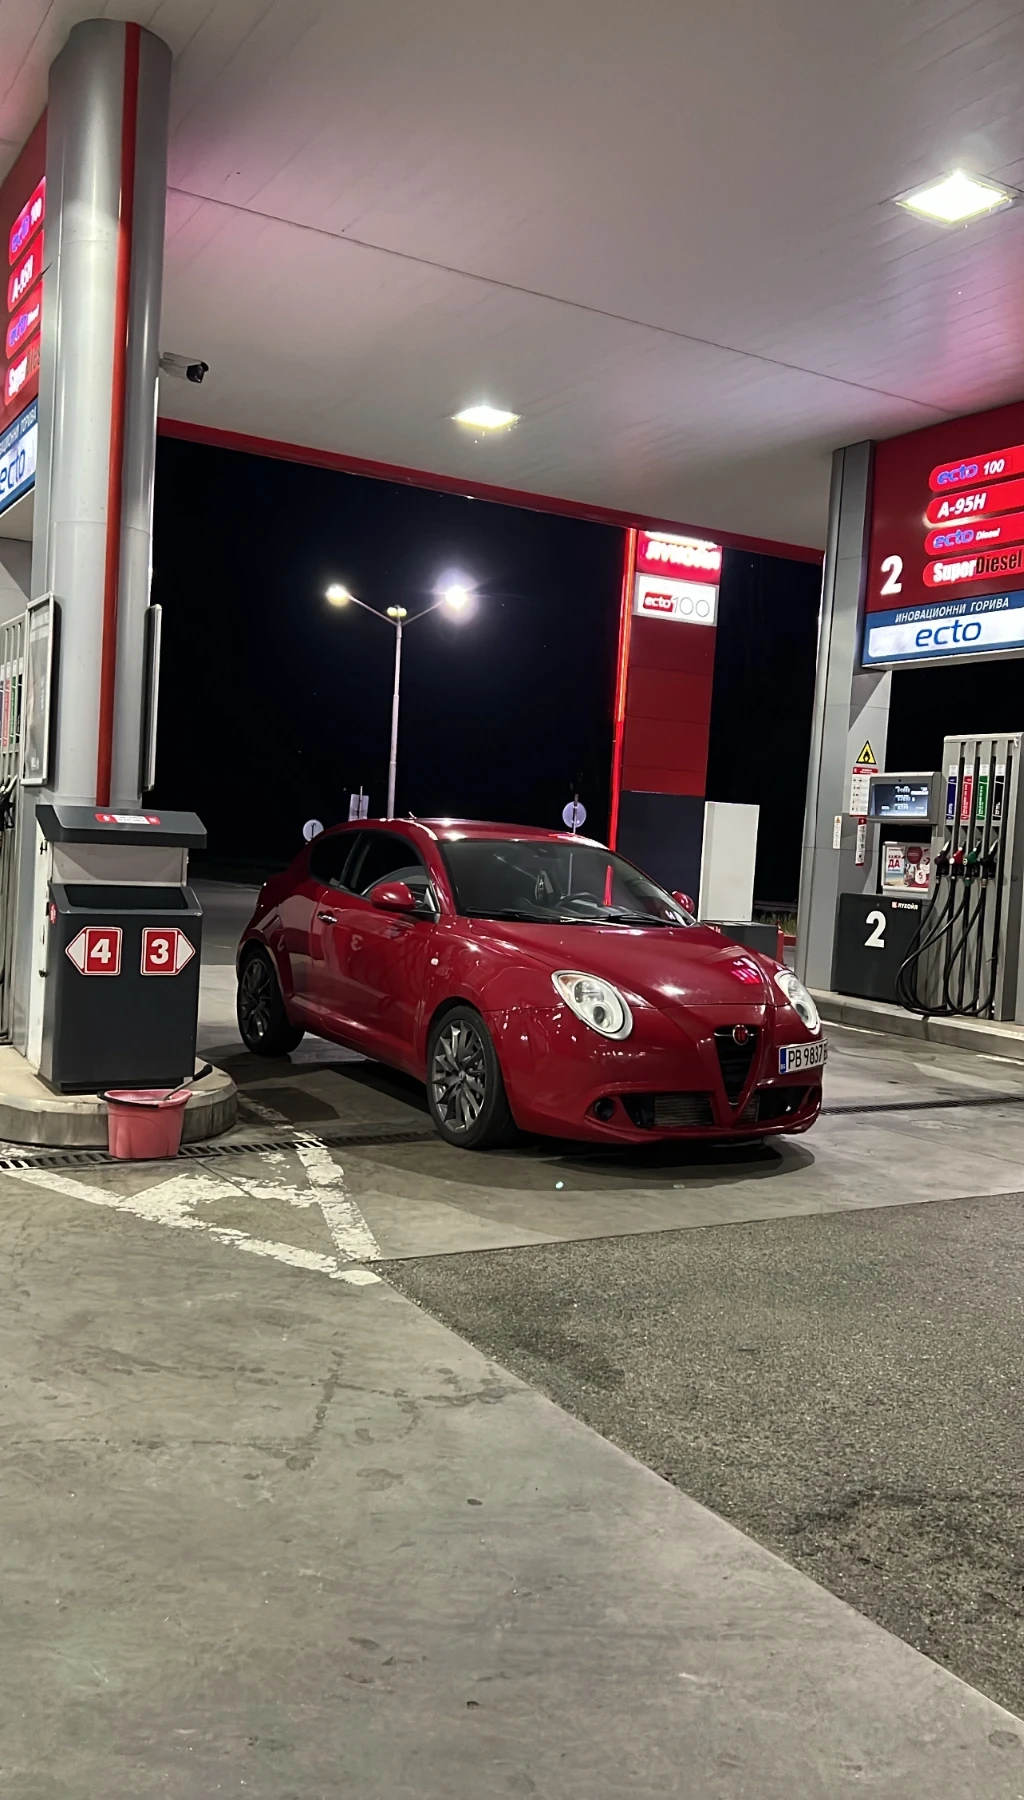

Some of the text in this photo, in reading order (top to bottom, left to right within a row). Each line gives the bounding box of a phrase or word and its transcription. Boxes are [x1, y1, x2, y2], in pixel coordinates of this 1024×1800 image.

[937, 459, 1005, 485] ecto 100
[933, 529, 974, 548] ecto
[880, 555, 903, 596] 2
[895, 597, 1009, 623] ИНОВАЦИОННИ ГОРИВА
[915, 619, 982, 647] ecto
[864, 911, 886, 948] 2
[90, 939, 111, 964] 4
[150, 939, 169, 964] 3
[788, 1049, 802, 1069] PB
[803, 1044, 823, 1066] 9837
